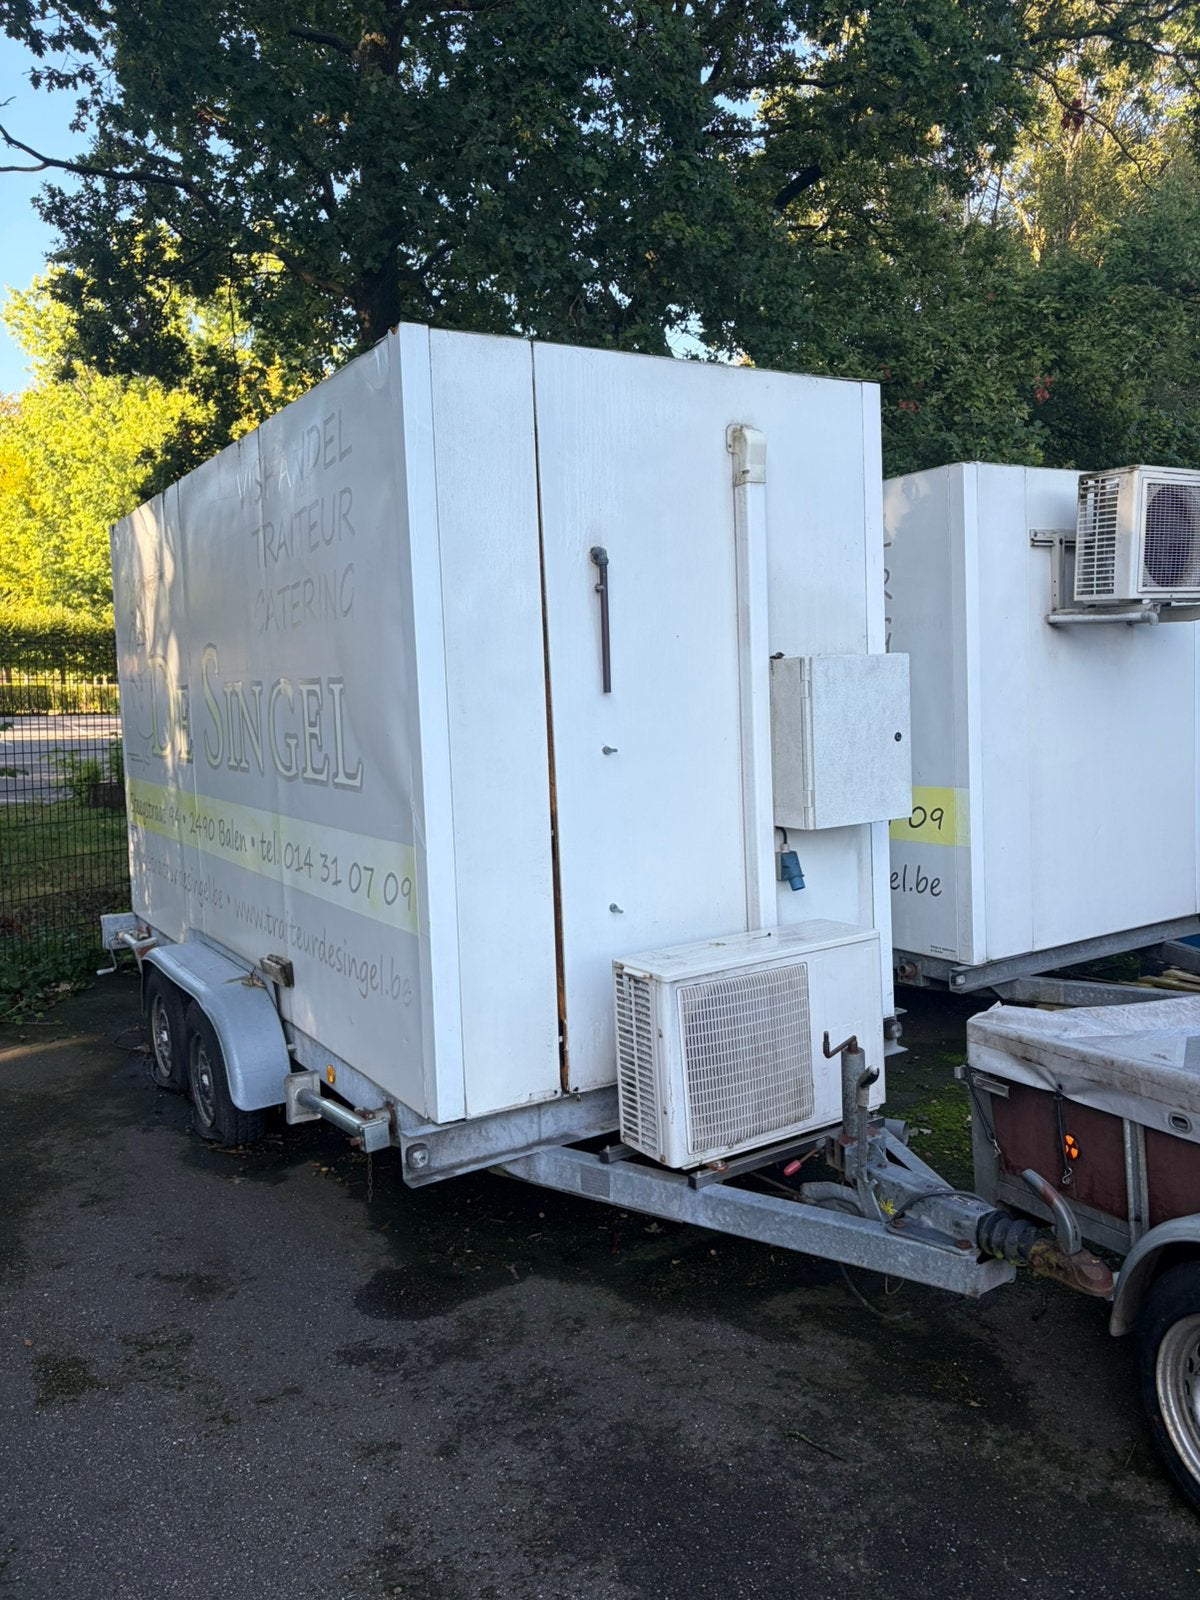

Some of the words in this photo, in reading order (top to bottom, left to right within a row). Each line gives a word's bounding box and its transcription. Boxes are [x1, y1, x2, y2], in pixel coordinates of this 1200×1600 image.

[252, 486, 355, 569] TRAITEUR
[258, 562, 355, 635] CATERING
[201, 642, 363, 792] SINGEL
[189, 811, 215, 841] 2490
[218, 818, 249, 853] Balen
[260, 830, 280, 865] tel.
[283, 842, 314, 879] 014
[319, 852, 342, 887] 31
[349, 862, 375, 899] 07
[383, 871, 412, 912] 09
[908, 804, 945, 831] 09
[233, 896, 413, 1008] www.traiteurdesingel.be
